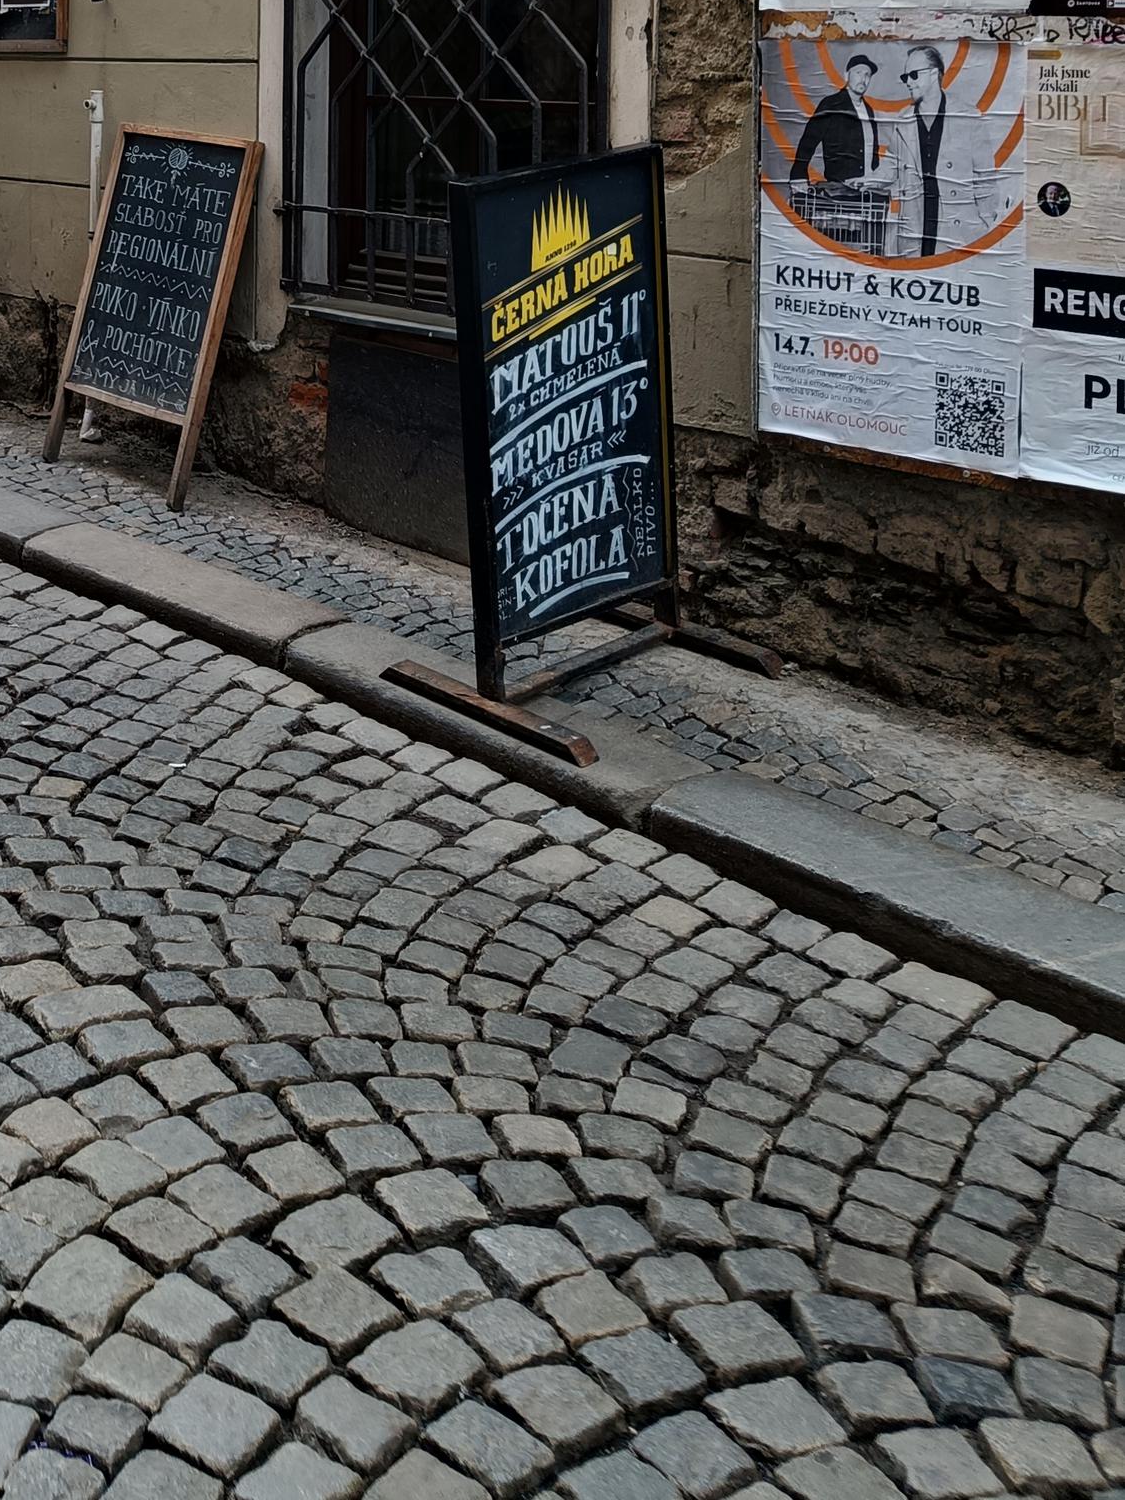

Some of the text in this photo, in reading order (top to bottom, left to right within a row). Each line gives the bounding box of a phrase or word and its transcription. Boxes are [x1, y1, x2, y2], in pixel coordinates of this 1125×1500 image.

[1039, 65, 1091, 80] Jak jsme
[1039, 79, 1078, 92] získali
[172, 183, 231, 217] MÁTE
[106, 230, 219, 278] REGIONÁLNÍ
[193, 218, 222, 244] PRO
[491, 234, 634, 342] ČERNÁ HORA
[776, 264, 980, 307] KRHUT & KOZUB
[91, 282, 200, 342] PIVKO VÍNKO
[775, 294, 983, 336] PŘEJEŽDĚNÝ VZTAH TOUR
[489, 297, 614, 415] MATOUŠ
[774, 332, 879, 365] 14.7. 19:00
[530, 342, 623, 406] CHMELENÁ
[491, 377, 648, 497] MEDOVÁ 13°
[785, 401, 907, 437] LETŇÁK OLOMOUC
[531, 440, 603, 488] KVASAR
[496, 464, 623, 575] TOČENÁ
[633, 468, 645, 558] NEALKO
[511, 524, 629, 612] KOFOLA
